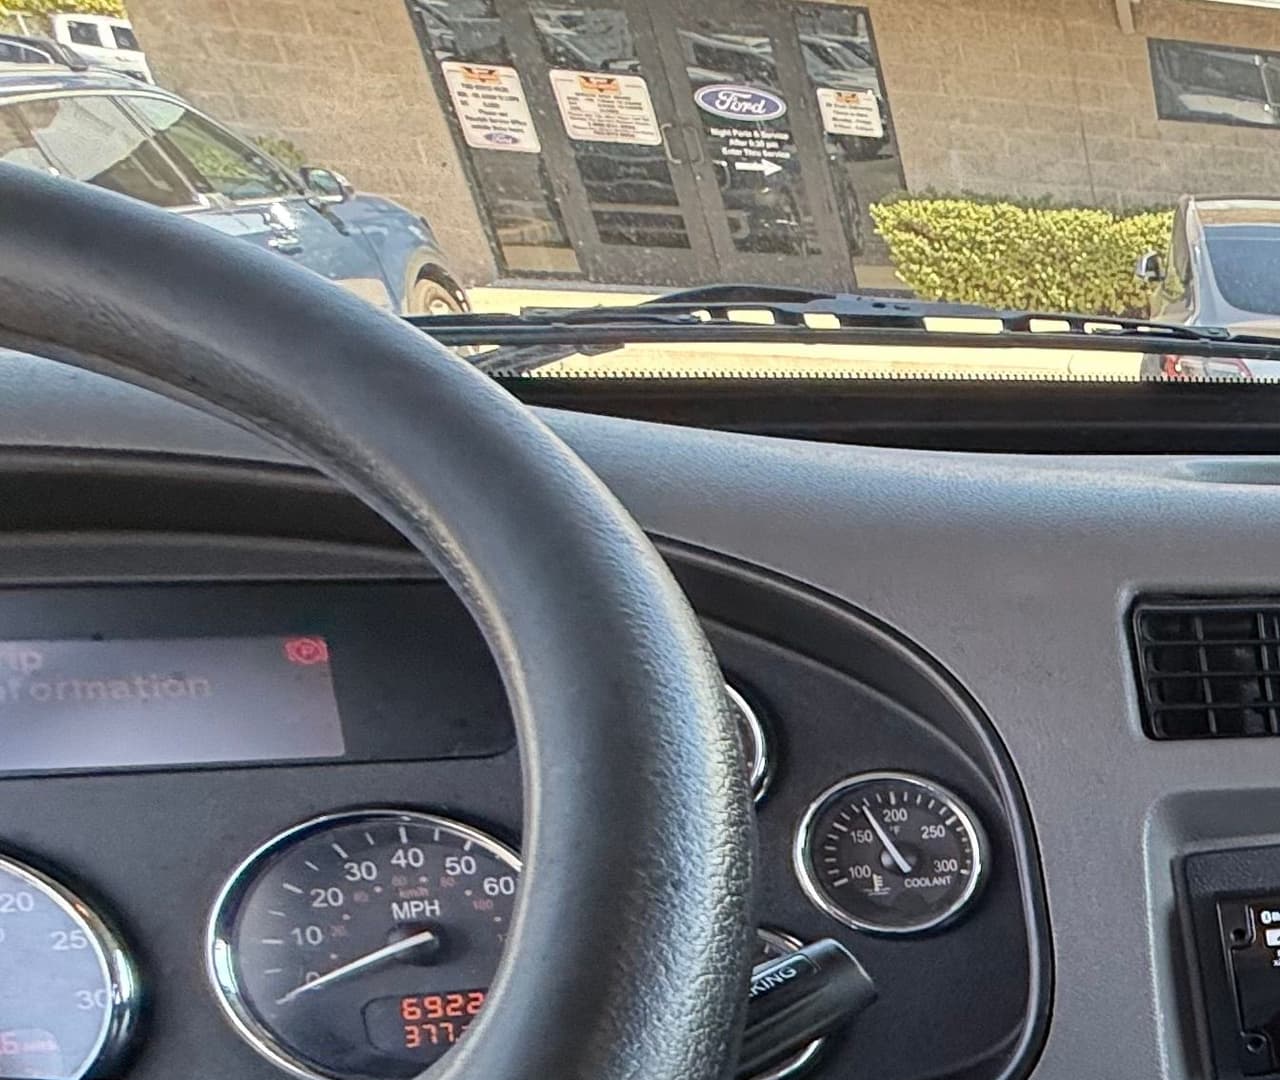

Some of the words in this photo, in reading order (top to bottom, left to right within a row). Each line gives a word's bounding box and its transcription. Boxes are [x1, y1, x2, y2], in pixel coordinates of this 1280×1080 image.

[715, 90, 766, 114] Ford
[0, 674, 209, 700] formation
[882, 808, 908, 822] 200
[850, 830, 873, 843] 150
[921, 825, 945, 839] 250
[390, 848, 425, 868] 40
[445, 856, 476, 875] 50
[934, 859, 958, 873] 300
[344, 861, 377, 881] 30
[849, 864, 871, 878] 100
[483, 876, 515, 896] 60
[904, 876, 952, 888] COOLANT
[310, 887, 344, 908] 20
[391, 900, 441, 920] MPH
[51, 930, 87, 950] 25
[292, 926, 323, 945] 10
